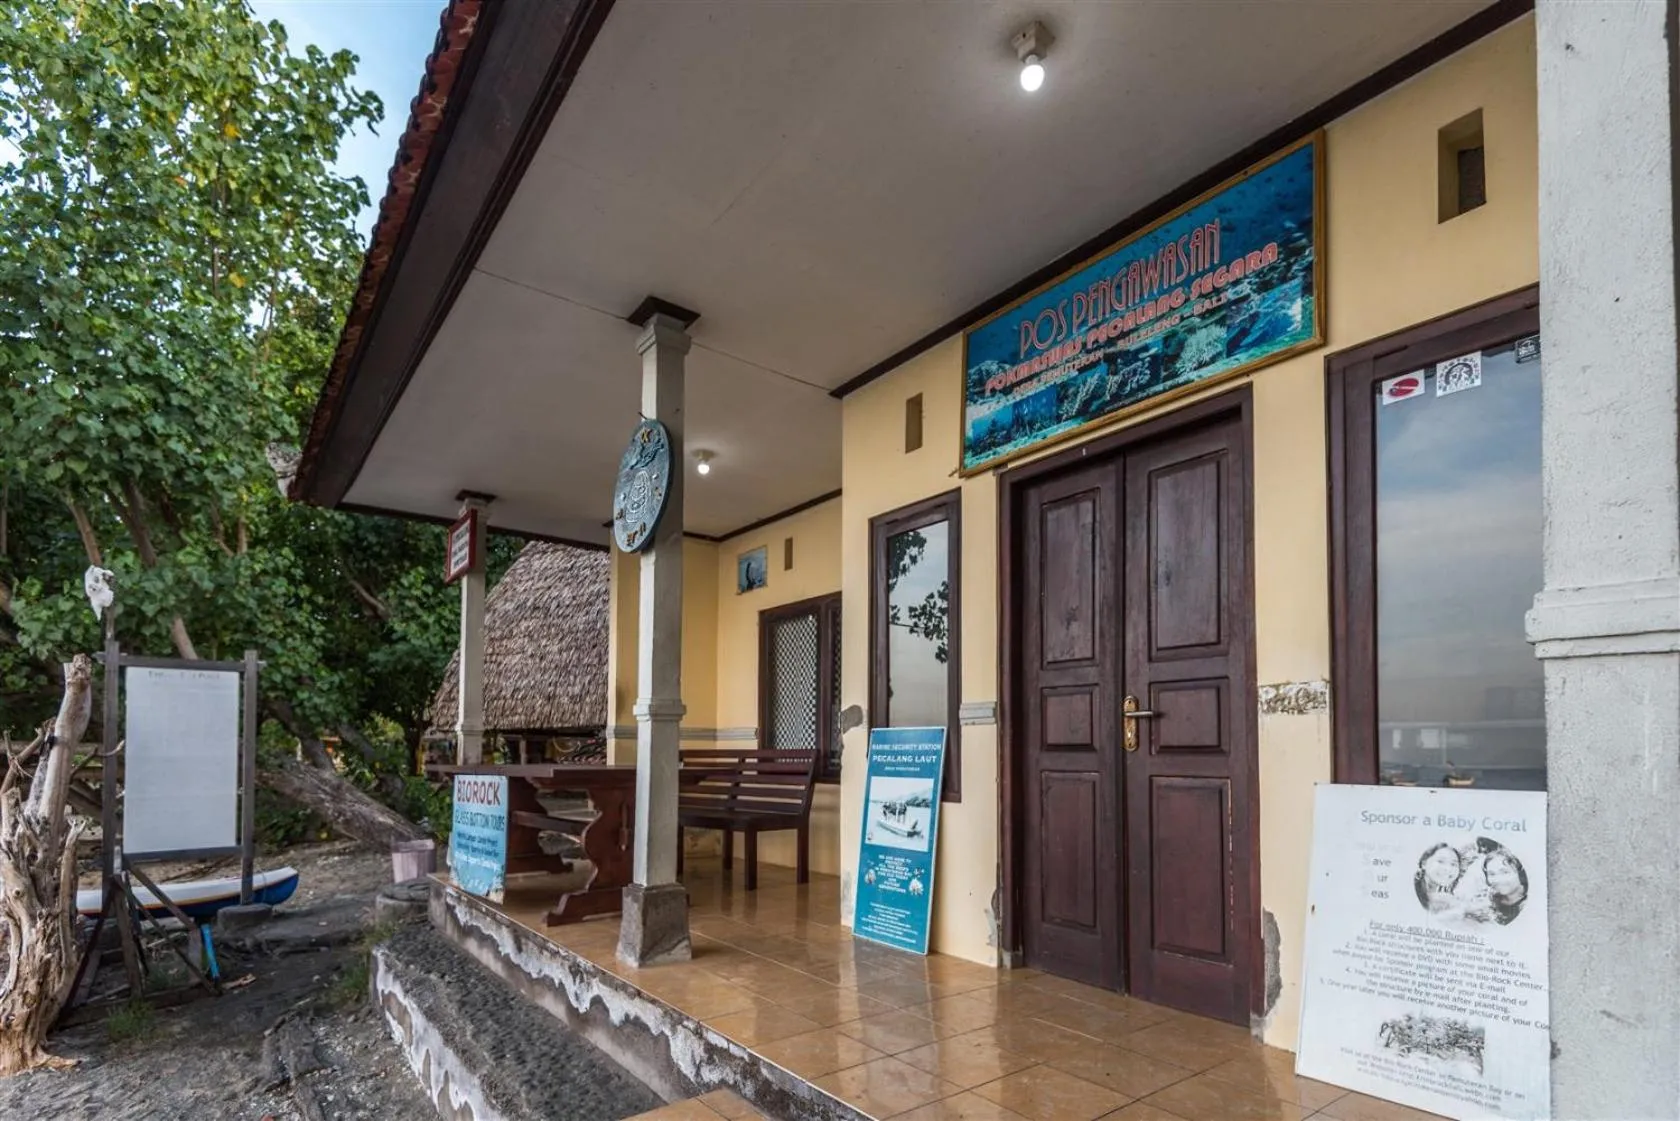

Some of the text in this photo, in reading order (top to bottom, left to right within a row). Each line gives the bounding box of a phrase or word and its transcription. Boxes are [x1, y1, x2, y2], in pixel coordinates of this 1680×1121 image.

[1190, 242, 1278, 299] SEGARA
[1021, 217, 1220, 359] POS PENGAWASAN
[1194, 292, 1228, 316] BALI
[872, 755, 937, 763] PECALANG LAUT
[457, 780, 501, 806] BIOROCK
[1361, 810, 1527, 832] Sponsor a Baby Coral
[1385, 922, 1403, 932] only
[1445, 931, 1477, 943] Rupiah
[1435, 957, 1451, 966] with
[1477, 964, 1498, 974] small
[1485, 957, 1502, 966] next
[1506, 960, 1515, 968] to
[1378, 965, 1416, 977] certificate
[1446, 977, 1462, 986] sent
[1379, 982, 1412, 994] structure
[1414, 989, 1423, 997] by
[1452, 996, 1470, 1005] after
[1418, 981, 1445, 993] picture
[1447, 986, 1455, 994] of
[1501, 996, 1516, 1005] and
[1407, 995, 1434, 1007] receive
[1437, 1001, 1466, 1013] another
[1469, 1008, 1497, 1021] picture
[1501, 1014, 1509, 1022] of
[1513, 1017, 1530, 1027] your
